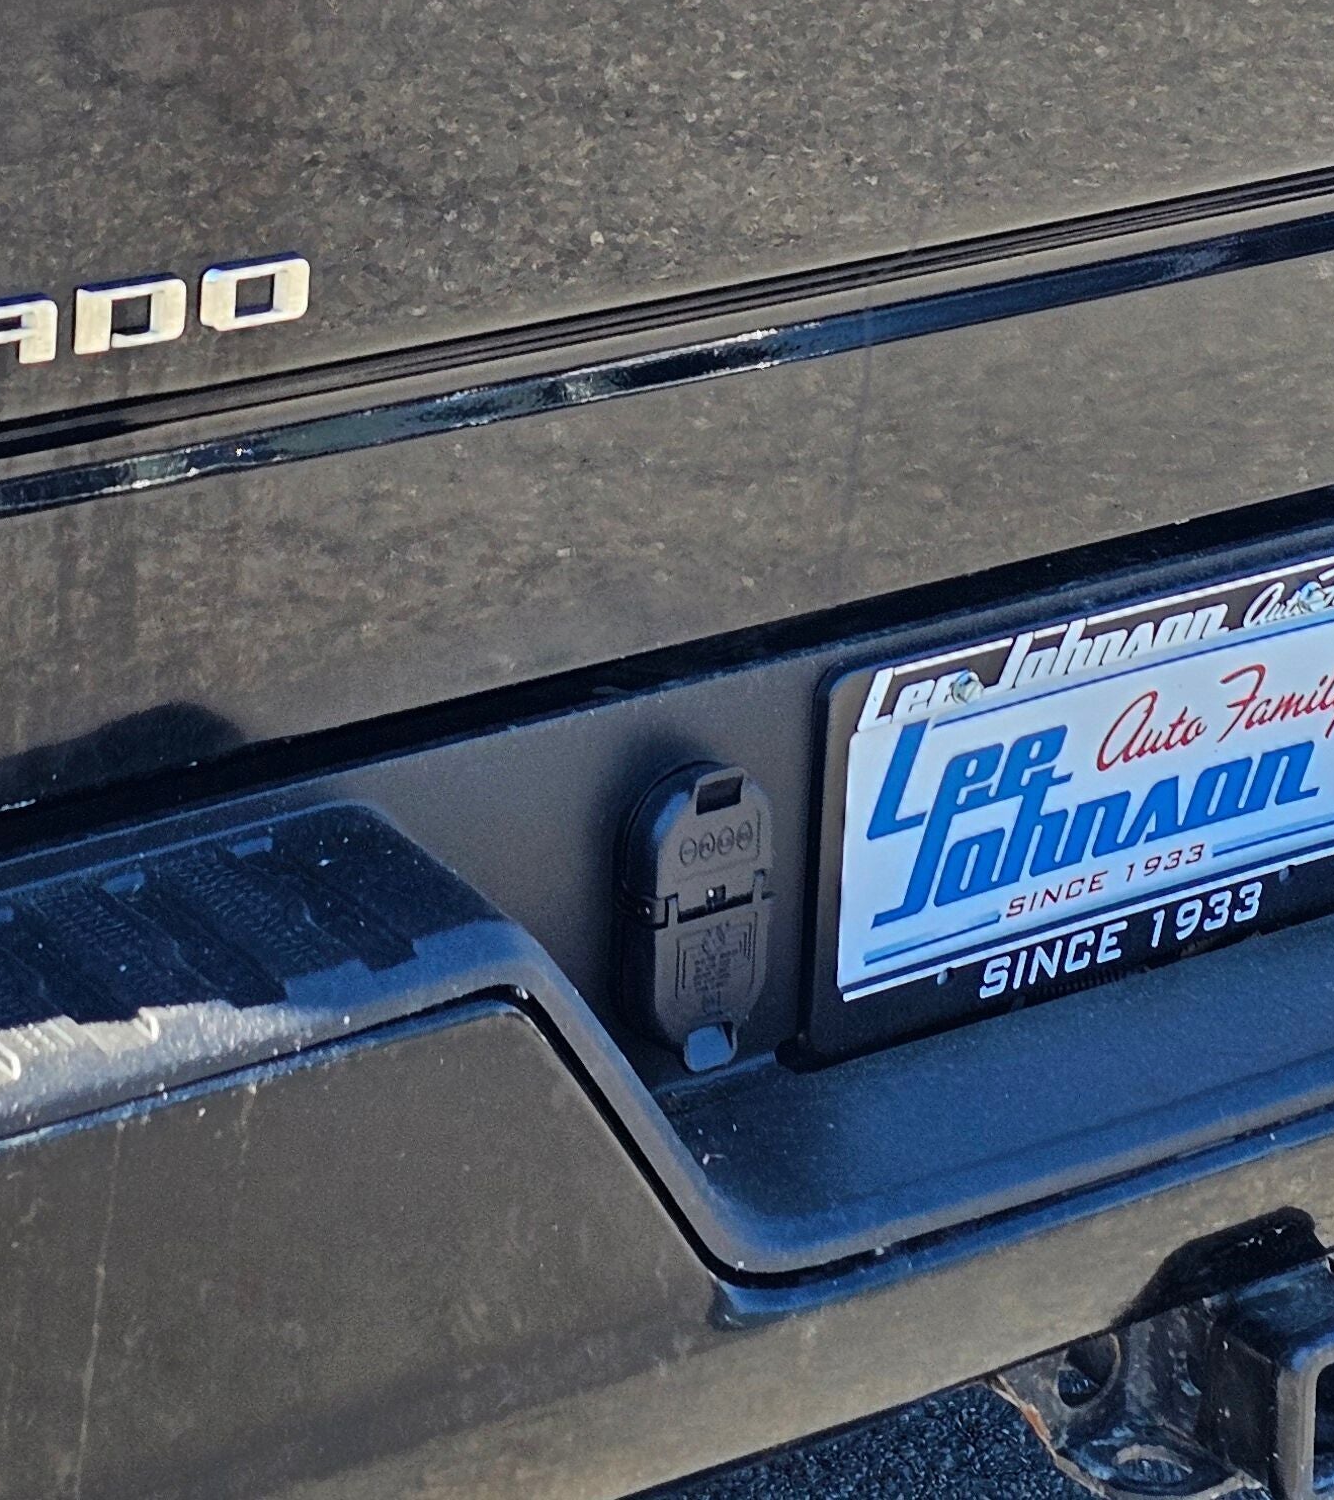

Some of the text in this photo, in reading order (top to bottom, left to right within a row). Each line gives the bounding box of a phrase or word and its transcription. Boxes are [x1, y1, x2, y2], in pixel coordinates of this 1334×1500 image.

[992, 604, 1229, 691] Johnson
[1243, 582, 1322, 628] Aut
[866, 717, 1071, 841] Lee
[1096, 691, 1207, 772] Auto
[870, 739, 1320, 929] Johnson
[1006, 843, 1207, 918] SINCE 1933
[979, 882, 1264, 999] SINCE 1933
